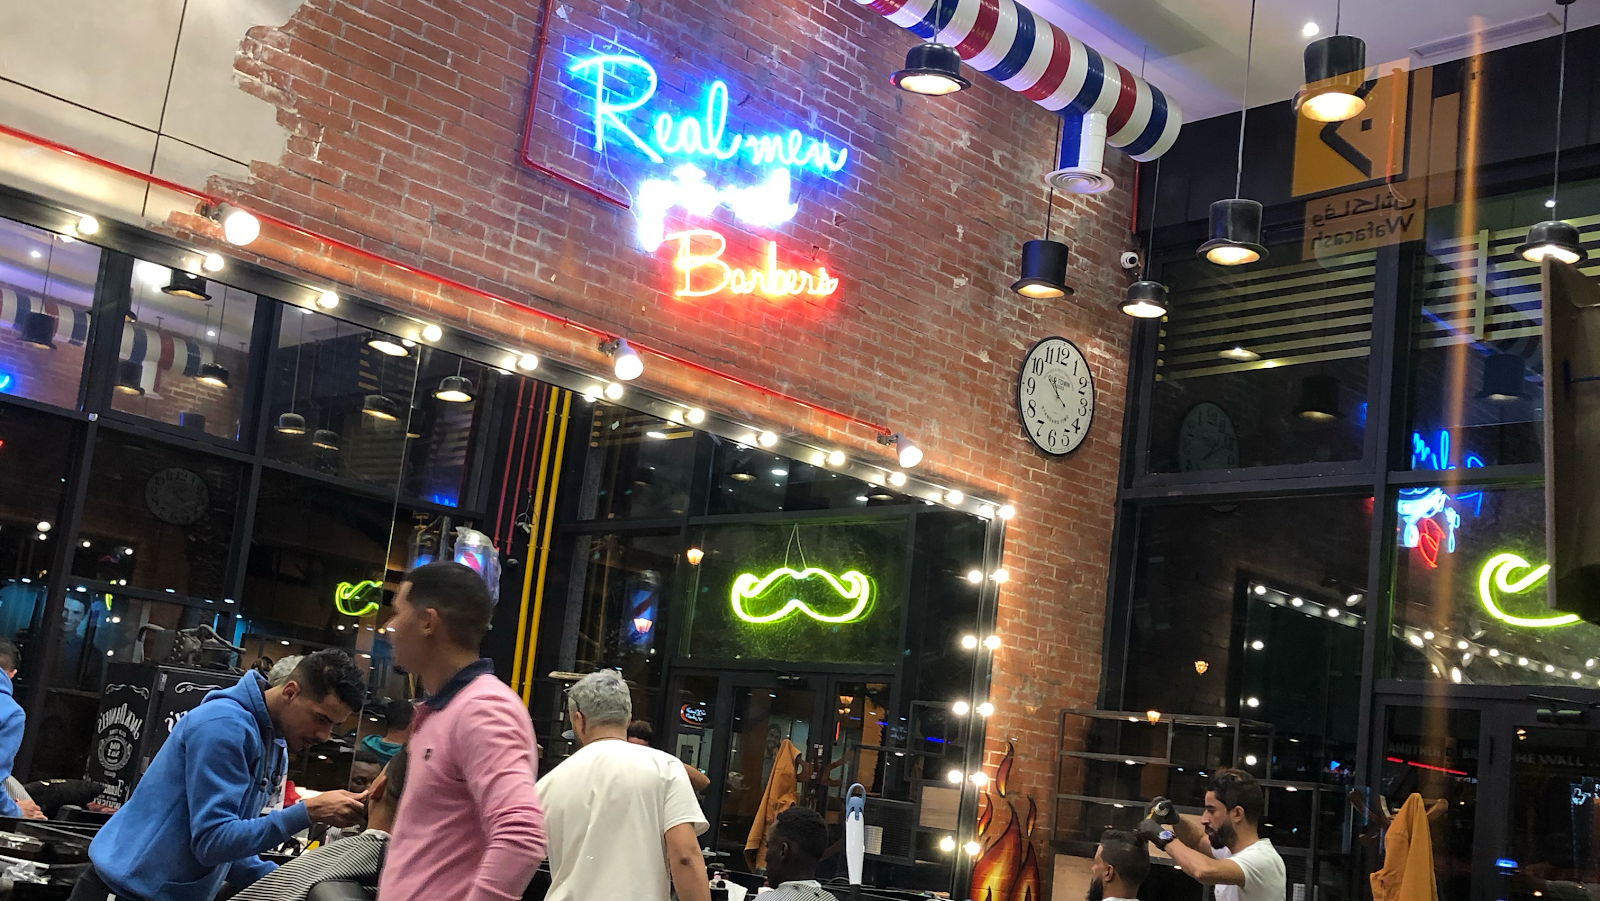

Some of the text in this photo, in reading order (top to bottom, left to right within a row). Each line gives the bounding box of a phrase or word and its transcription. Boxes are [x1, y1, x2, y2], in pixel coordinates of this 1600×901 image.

[569, 54, 849, 173] Real men
[664, 228, 839, 298] Barbers
[1044, 346, 1055, 366] 11
[1055, 345, 1070, 366] 12
[1032, 357, 1044, 376] 10
[1072, 360, 1079, 377] 1
[1026, 377, 1036, 395] 9
[1078, 376, 1088, 395] 2
[1026, 399, 1037, 418] 8
[1078, 398, 1088, 417] 3
[1036, 419, 1045, 438] 7
[1071, 418, 1081, 434] 4
[1047, 429, 1057, 448] 6
[1061, 428, 1070, 447] 5
